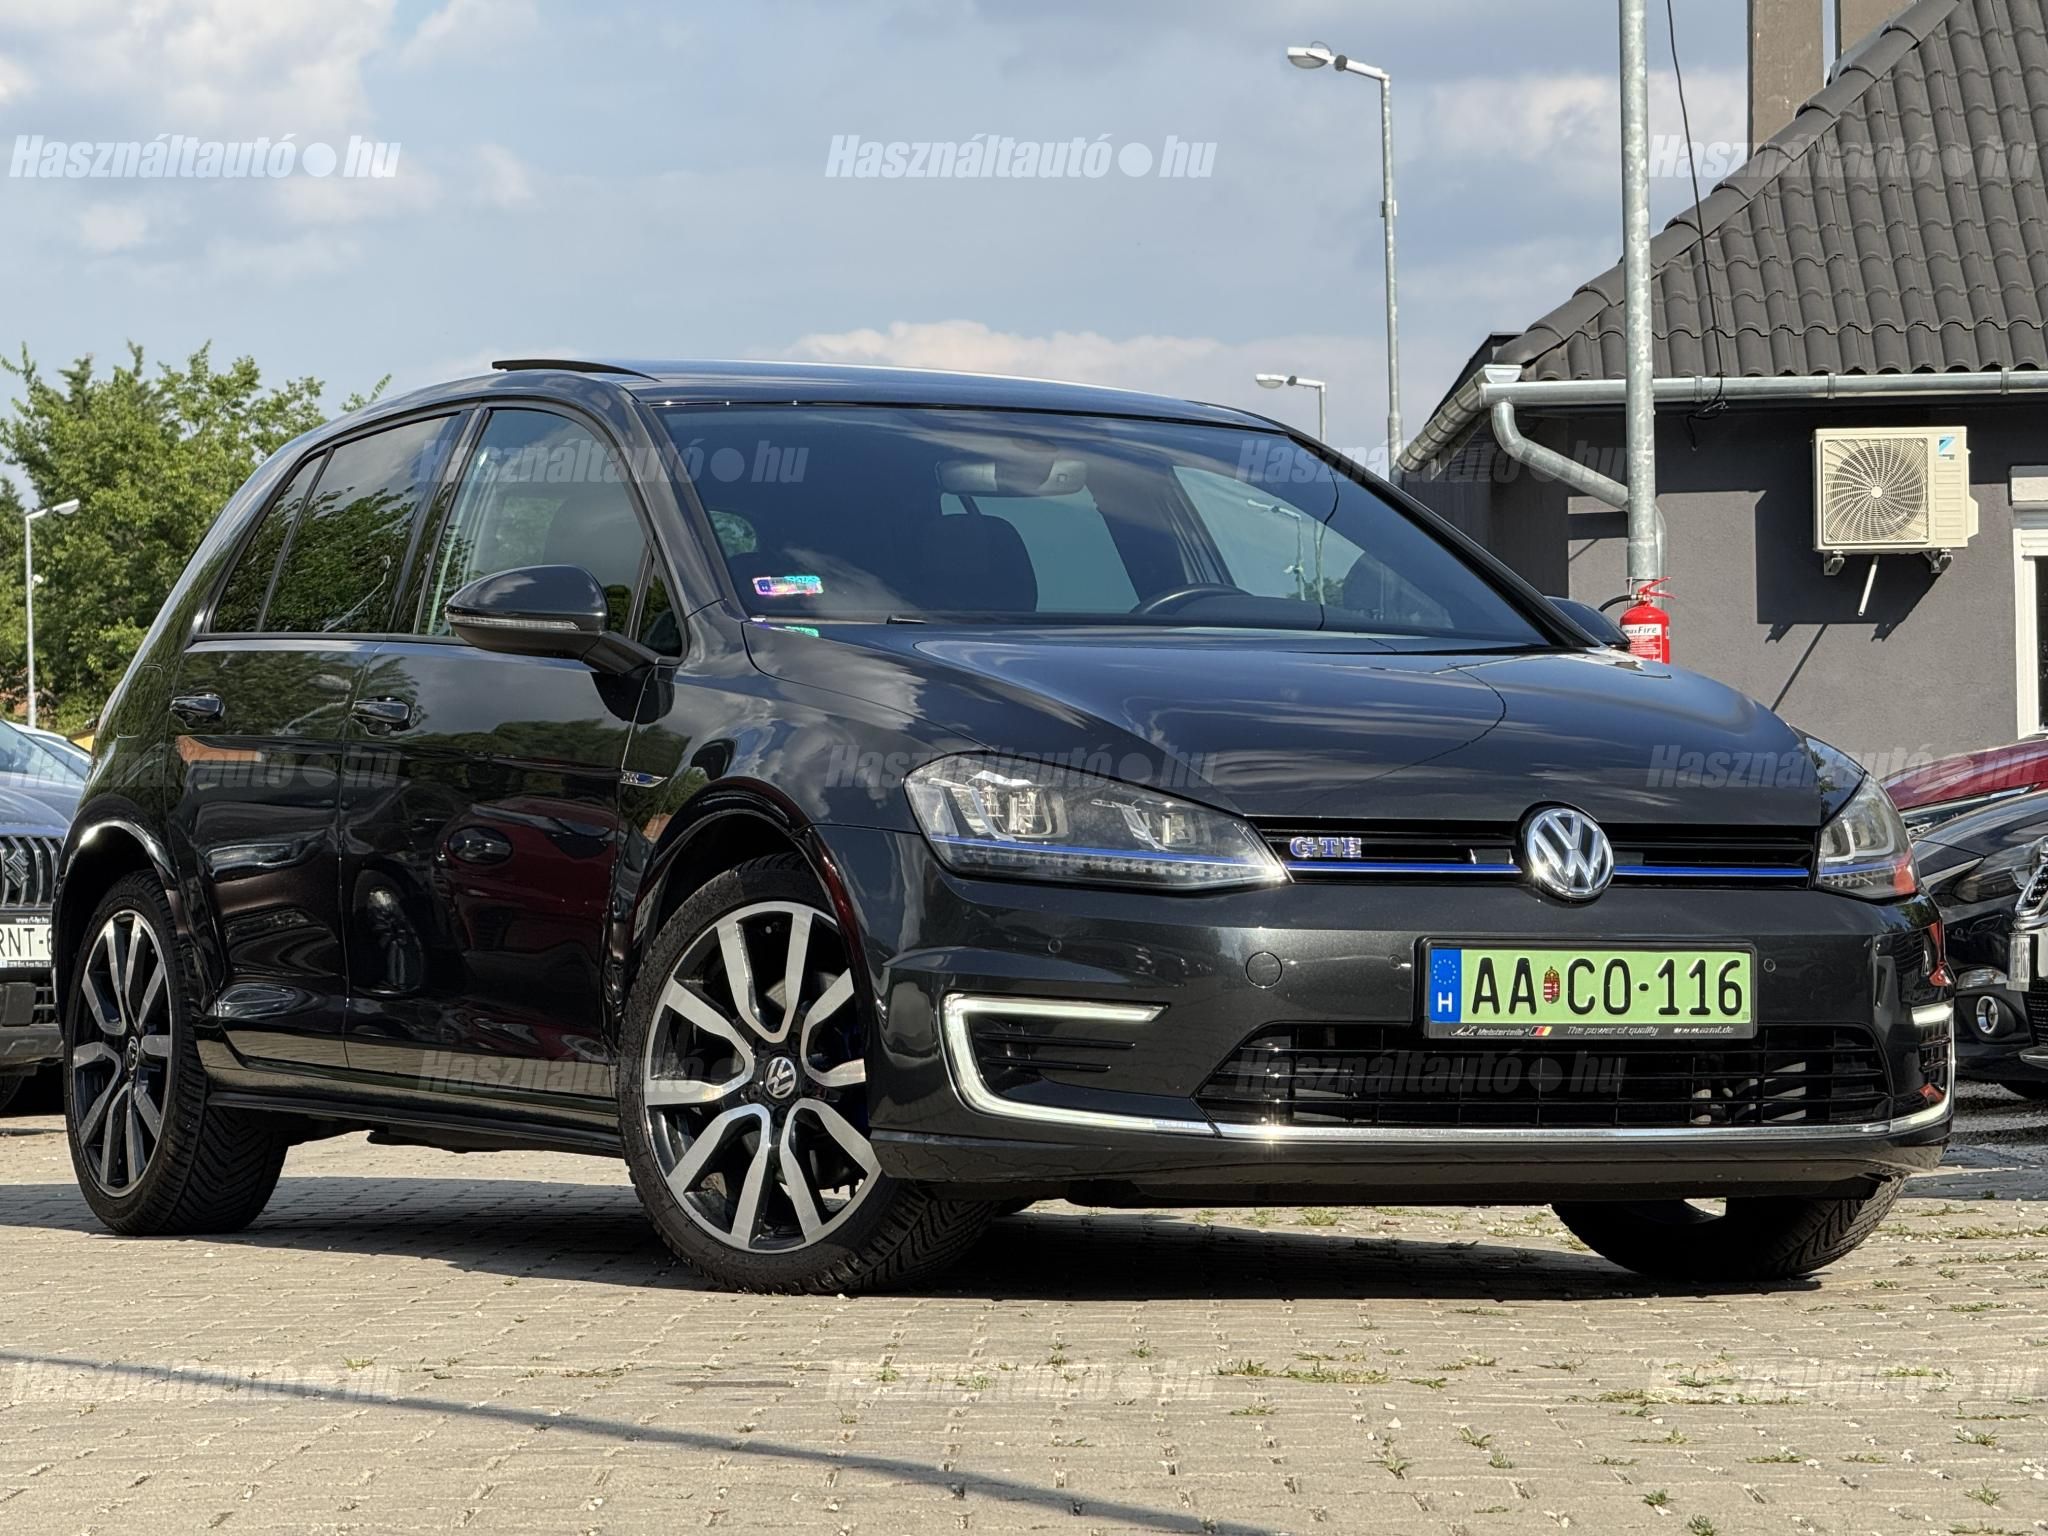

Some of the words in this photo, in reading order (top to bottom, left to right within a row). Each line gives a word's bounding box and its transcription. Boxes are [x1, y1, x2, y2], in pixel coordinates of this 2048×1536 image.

[1290, 836, 1361, 858] GTE
[1437, 991, 1453, 1013] H
[1567, 1026, 1584, 1034] The
[1584, 1027, 1616, 1036] power
[1617, 1026, 1628, 1034] of
[1628, 1026, 1659, 1037] quality
